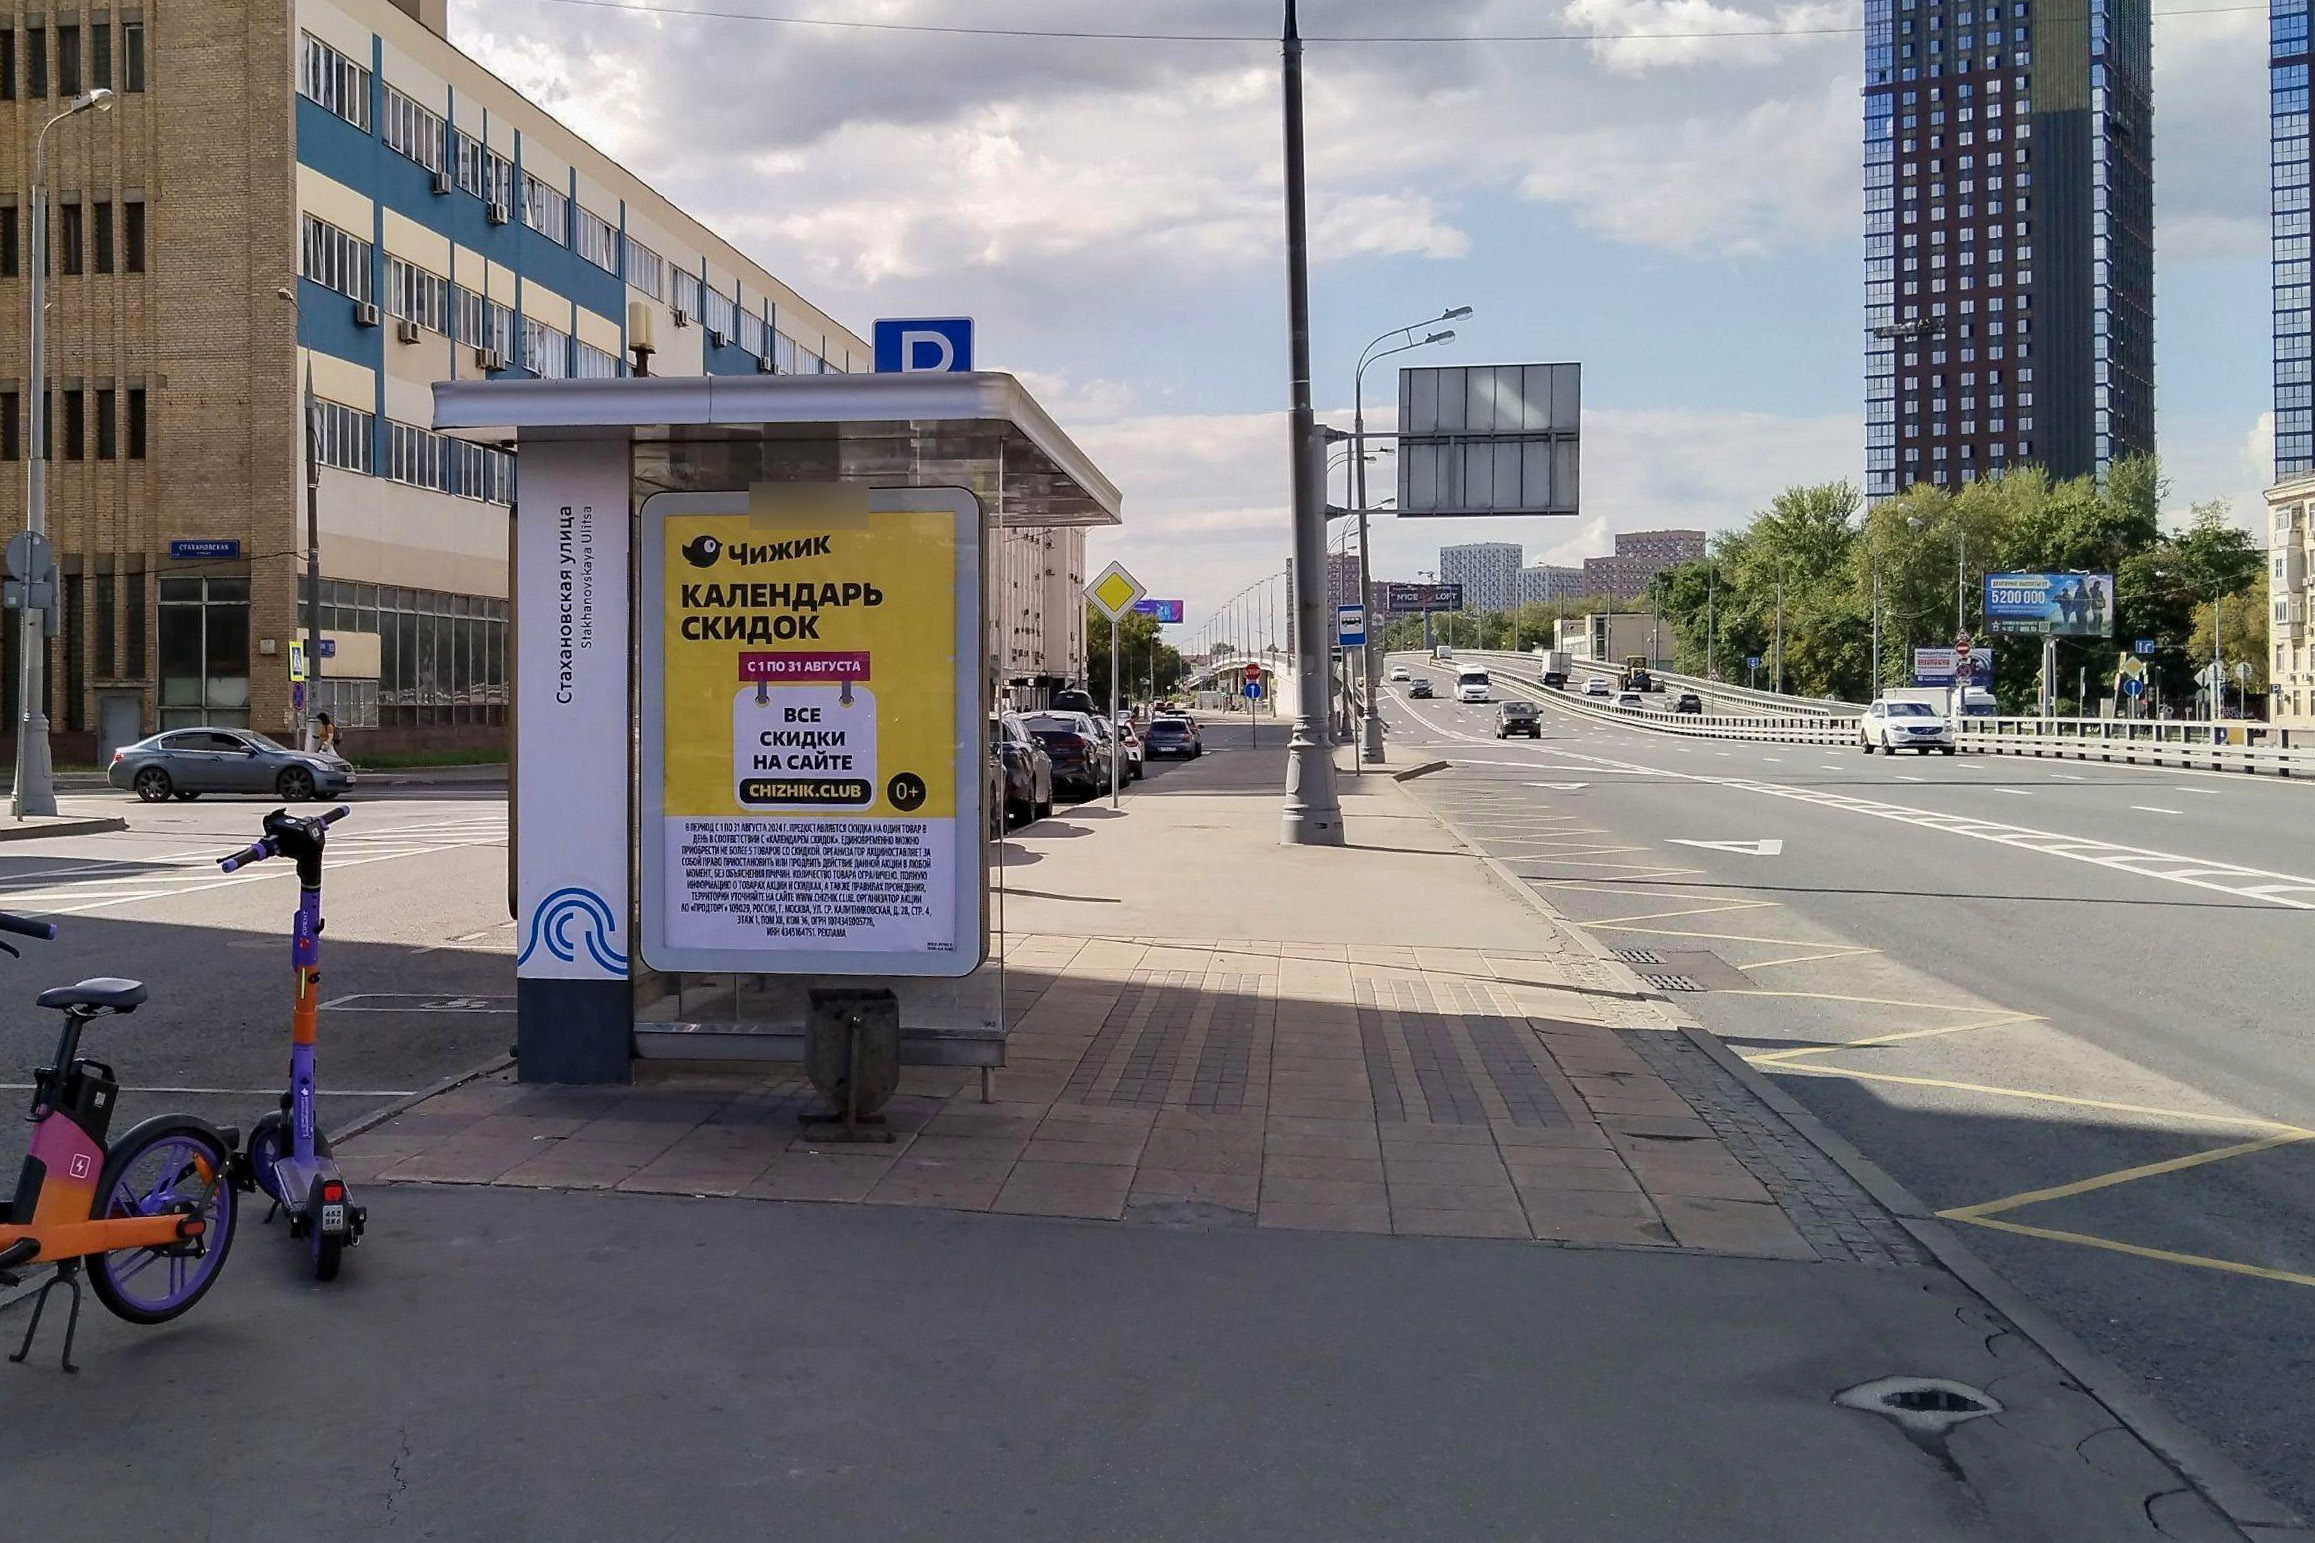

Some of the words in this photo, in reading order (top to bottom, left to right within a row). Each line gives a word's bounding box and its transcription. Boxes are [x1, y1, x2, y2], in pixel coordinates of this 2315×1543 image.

[581, 506, 593, 543] Ulitsa
[560, 506, 577, 564] улица
[581, 547, 595, 649] Stakhanovskaya
[682, 583, 884, 612] КАЛЕНДАРЬ
[556, 570, 573, 704] Стахановская
[681, 615, 821, 645] СКИДОК
[747, 661, 756, 672] С
[759, 661, 766, 672] 1
[767, 661, 785, 672] ПО
[788, 661, 802, 672] 31
[804, 660, 861, 672] АВГУСТА
[2272, 684, 2280, 694] P
[784, 708, 822, 723] ВСЕ
[760, 731, 846, 750] СКИДКИ
[753, 755, 782, 771] НА
[787, 750, 853, 771] САЙТЕ
[749, 783, 862, 799] CHIZHIK.CLUB
[896, 782, 920, 801] 0+
[741, 823, 767, 833] АВГУСТА
[768, 823, 783, 833] 2024
[848, 824, 872, 834] СКИДКА
[883, 824, 901, 834] ОДИН
[902, 824, 922, 834] ТОВАР
[754, 846, 781, 856] ТОВАРОВ
[703, 857, 723, 867] ПРАВО
[834, 869, 857, 880] ТОВАРА
[776, 893, 795, 903] САЙТЕ
[817, 929, 847, 938] РЕКЛАМА
